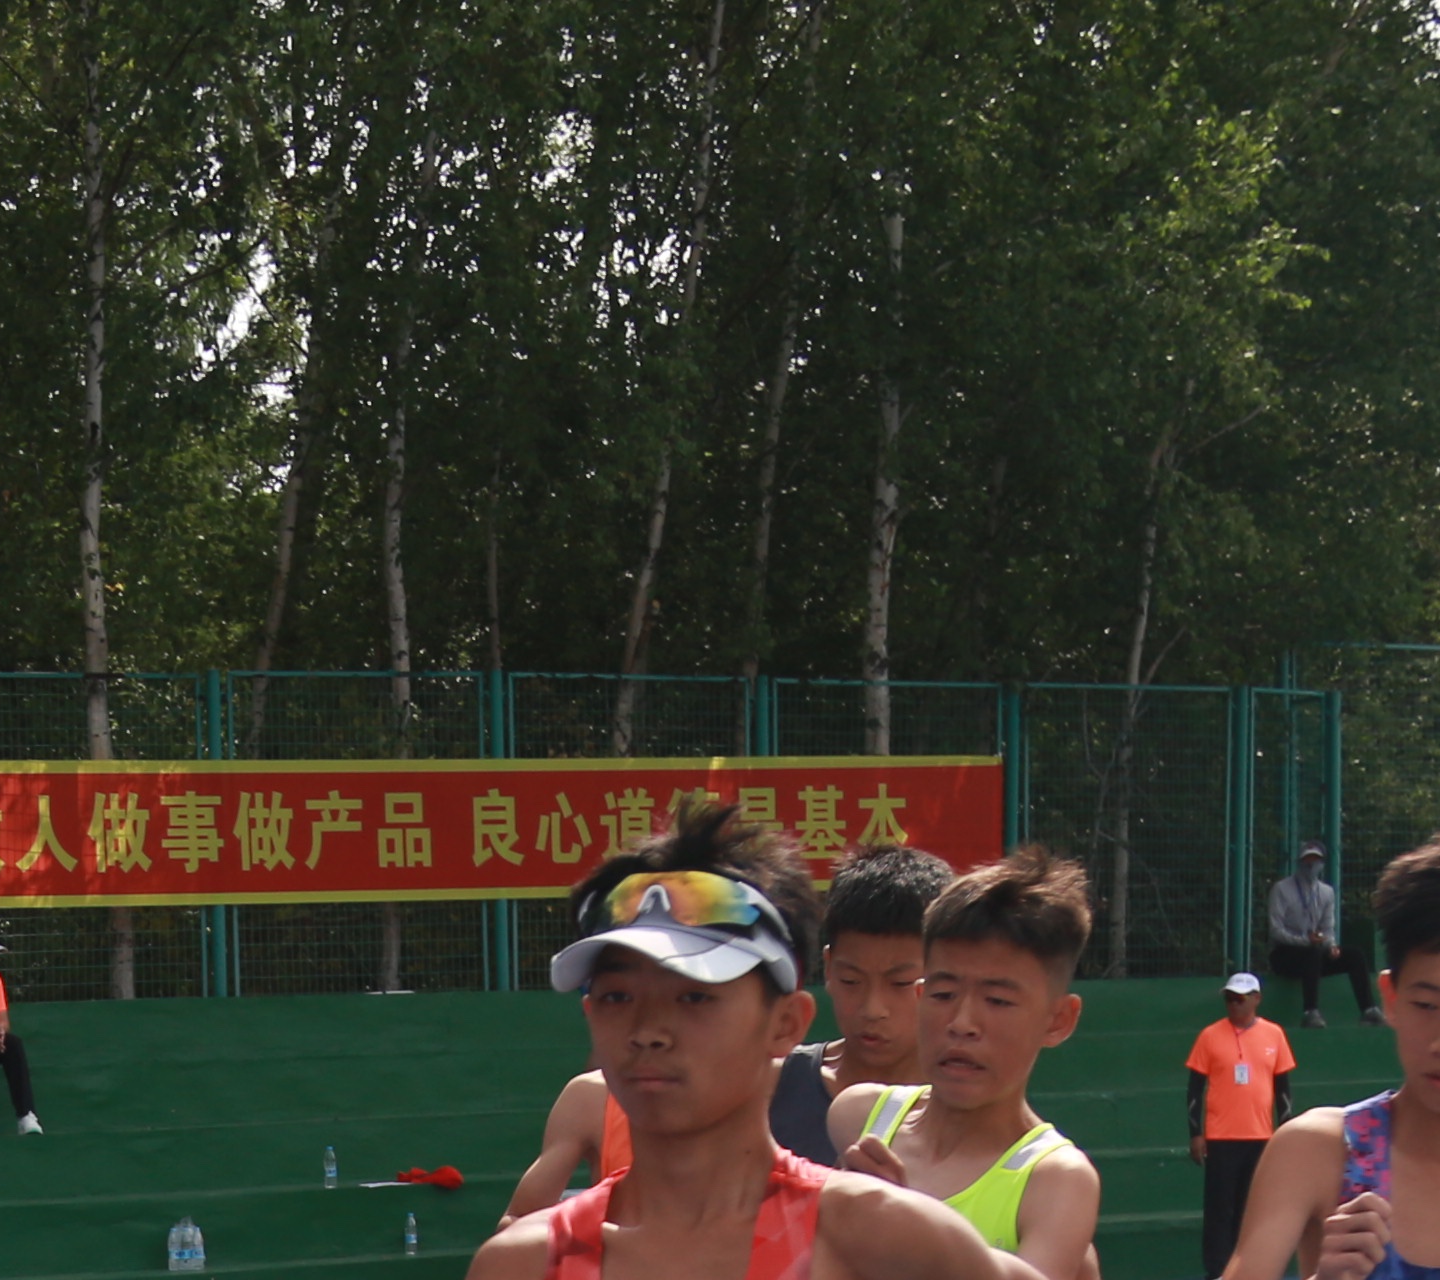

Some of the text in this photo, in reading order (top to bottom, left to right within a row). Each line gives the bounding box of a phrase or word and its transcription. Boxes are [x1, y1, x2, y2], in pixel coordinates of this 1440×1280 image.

[472, 783, 908, 868] 良心道是基本
